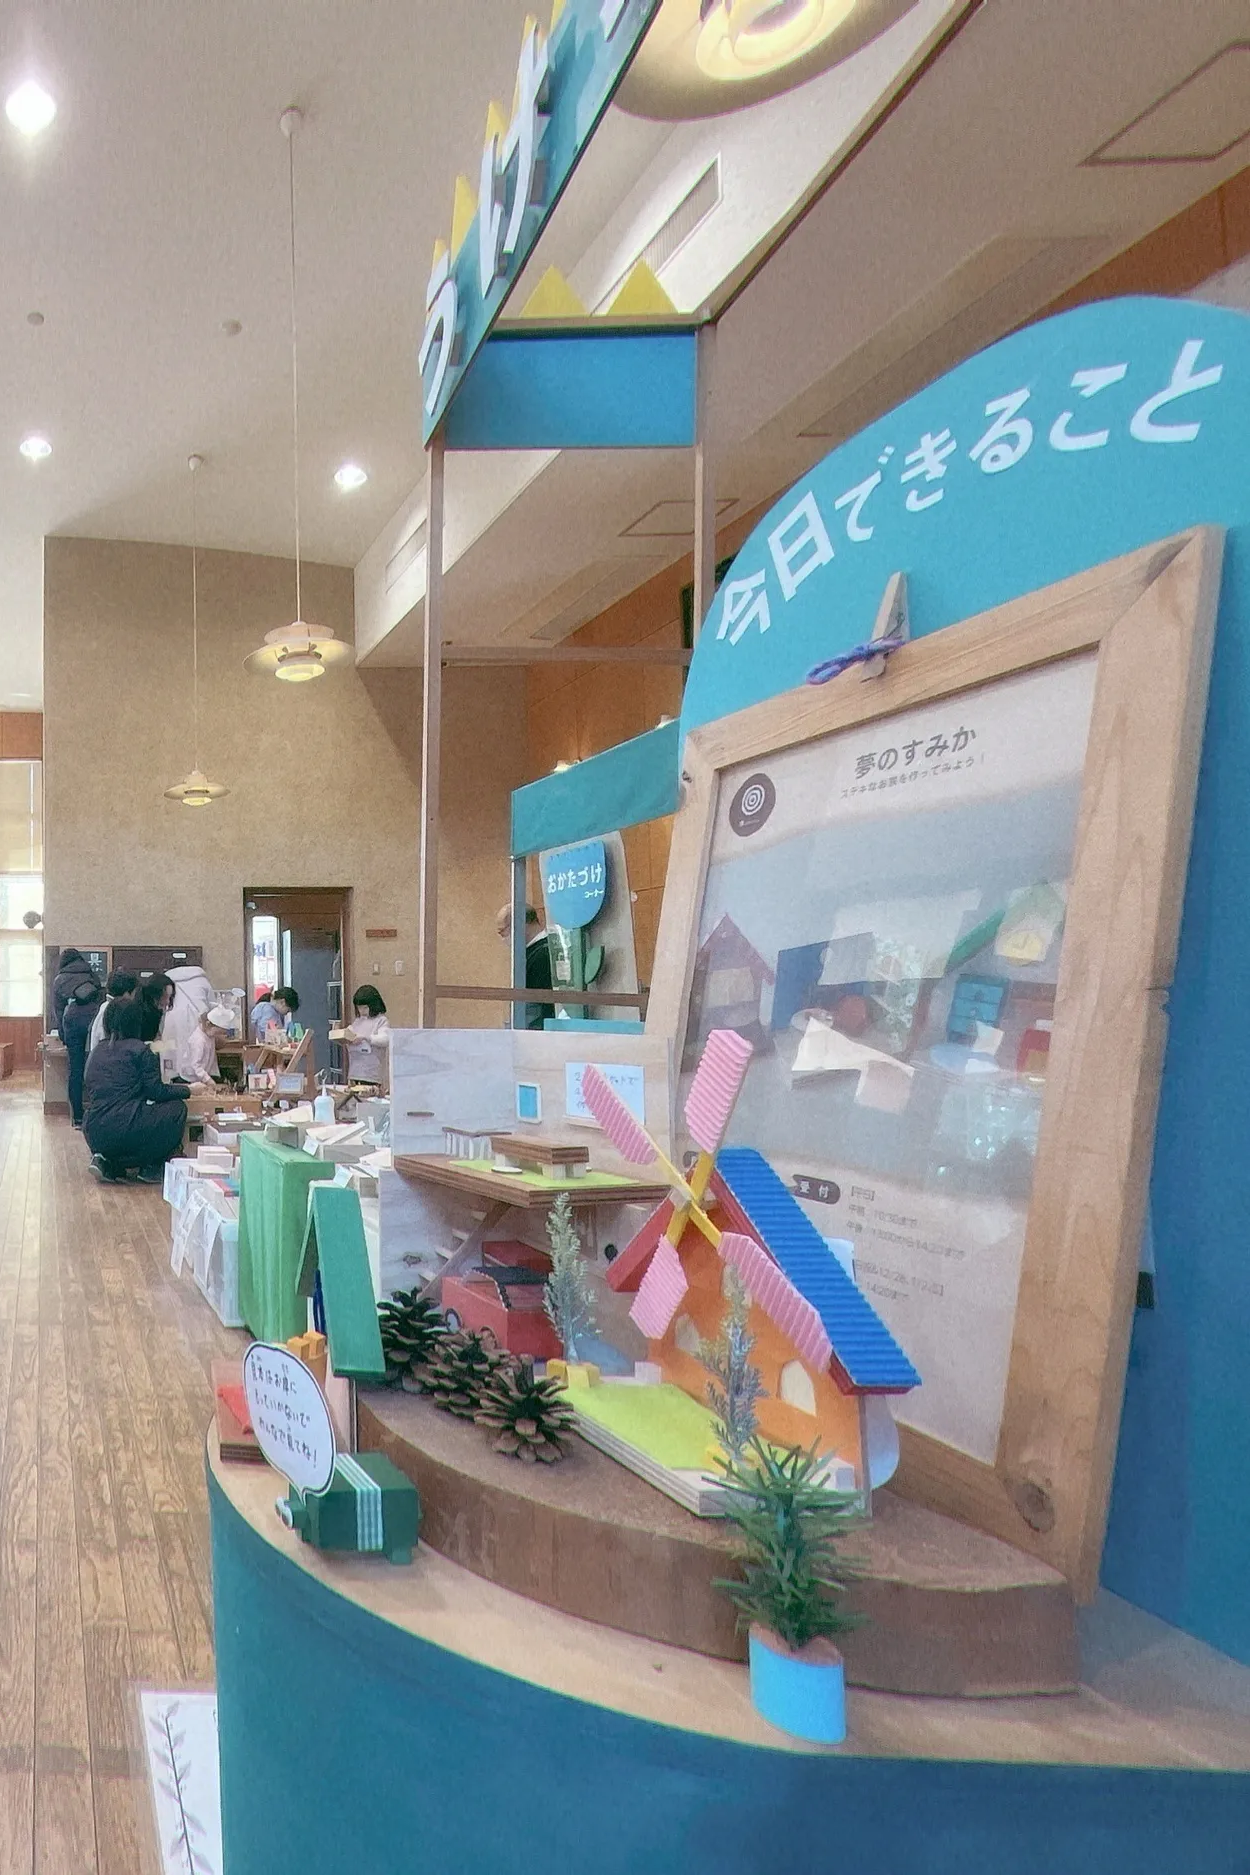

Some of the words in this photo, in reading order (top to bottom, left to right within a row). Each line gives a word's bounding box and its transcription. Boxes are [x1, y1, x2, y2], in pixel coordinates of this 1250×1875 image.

[716, 339, 1224, 646] 今日できること
[855, 726, 977, 780] 夢のすみか
[548, 863, 603, 893] おかたづけ
[584, 888, 605, 898] コーナー
[800, 1181, 830, 1199] 受付
